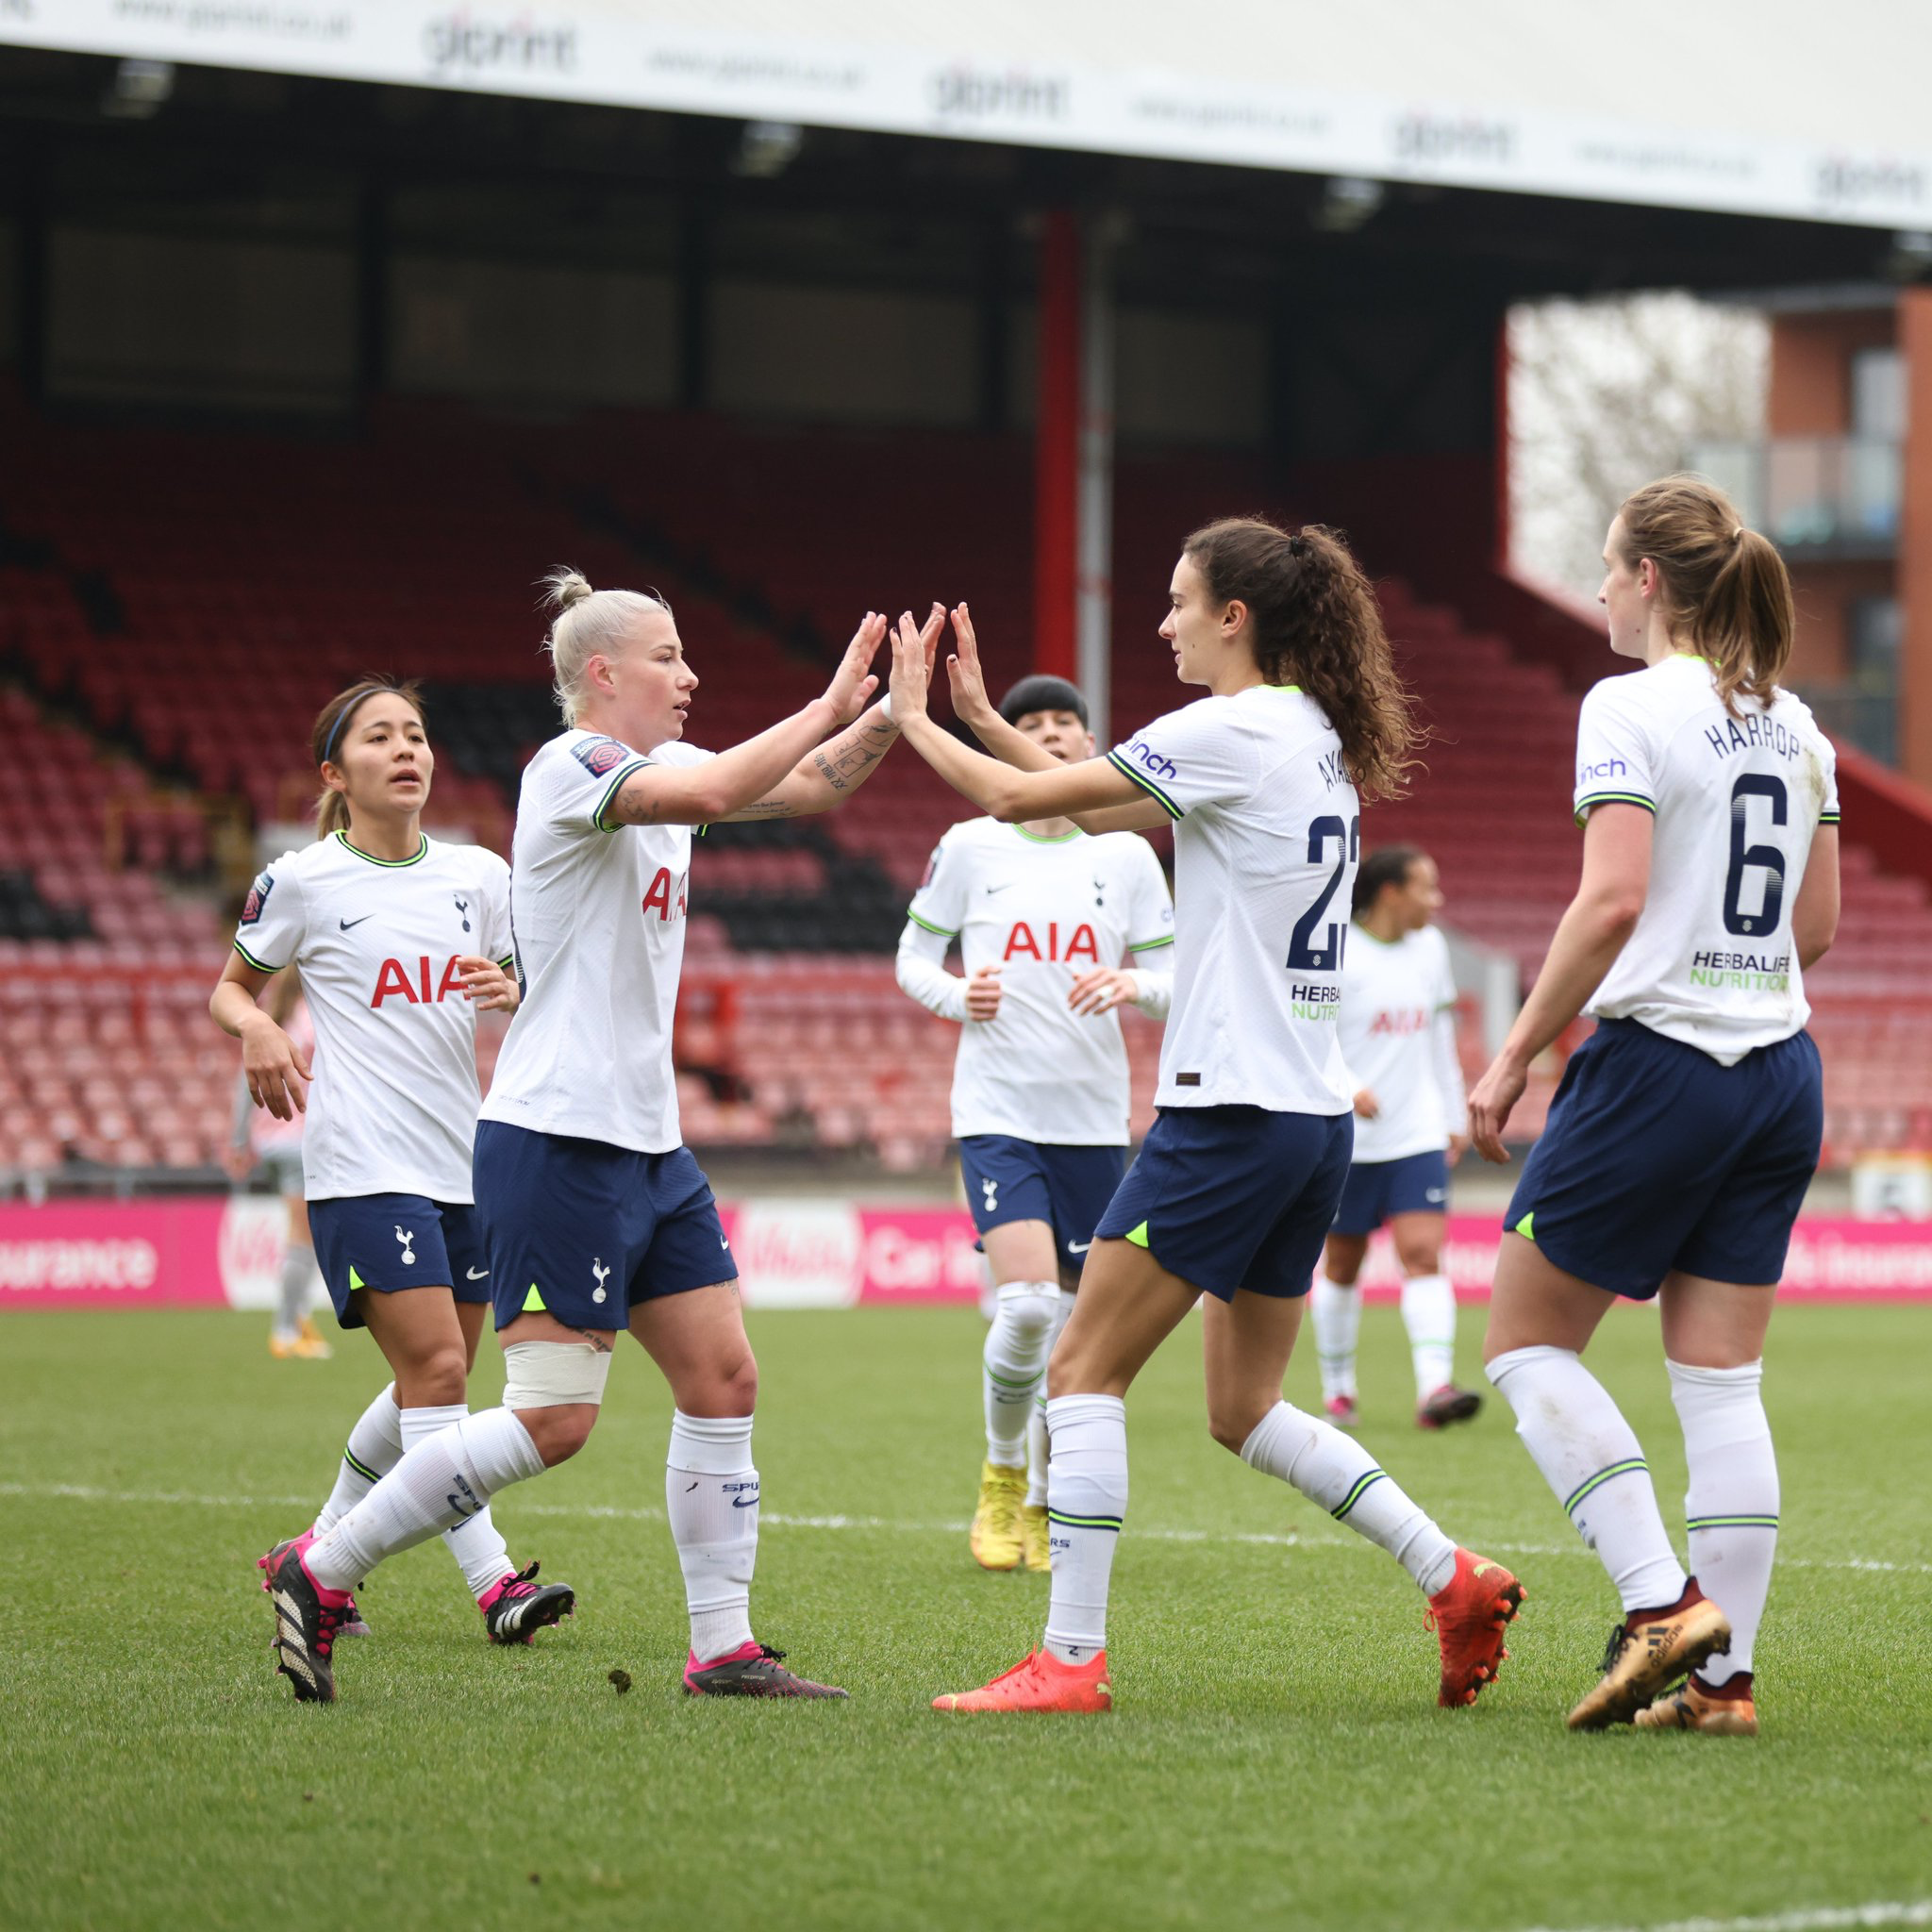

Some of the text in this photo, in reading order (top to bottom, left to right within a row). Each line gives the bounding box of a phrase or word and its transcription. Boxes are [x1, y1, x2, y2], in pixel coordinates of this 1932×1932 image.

[1704, 713, 1800, 761] HARROP
[1723, 773, 1788, 938] 6
[1004, 922, 1098, 963] AIA
[371, 955, 471, 1008] AIA
